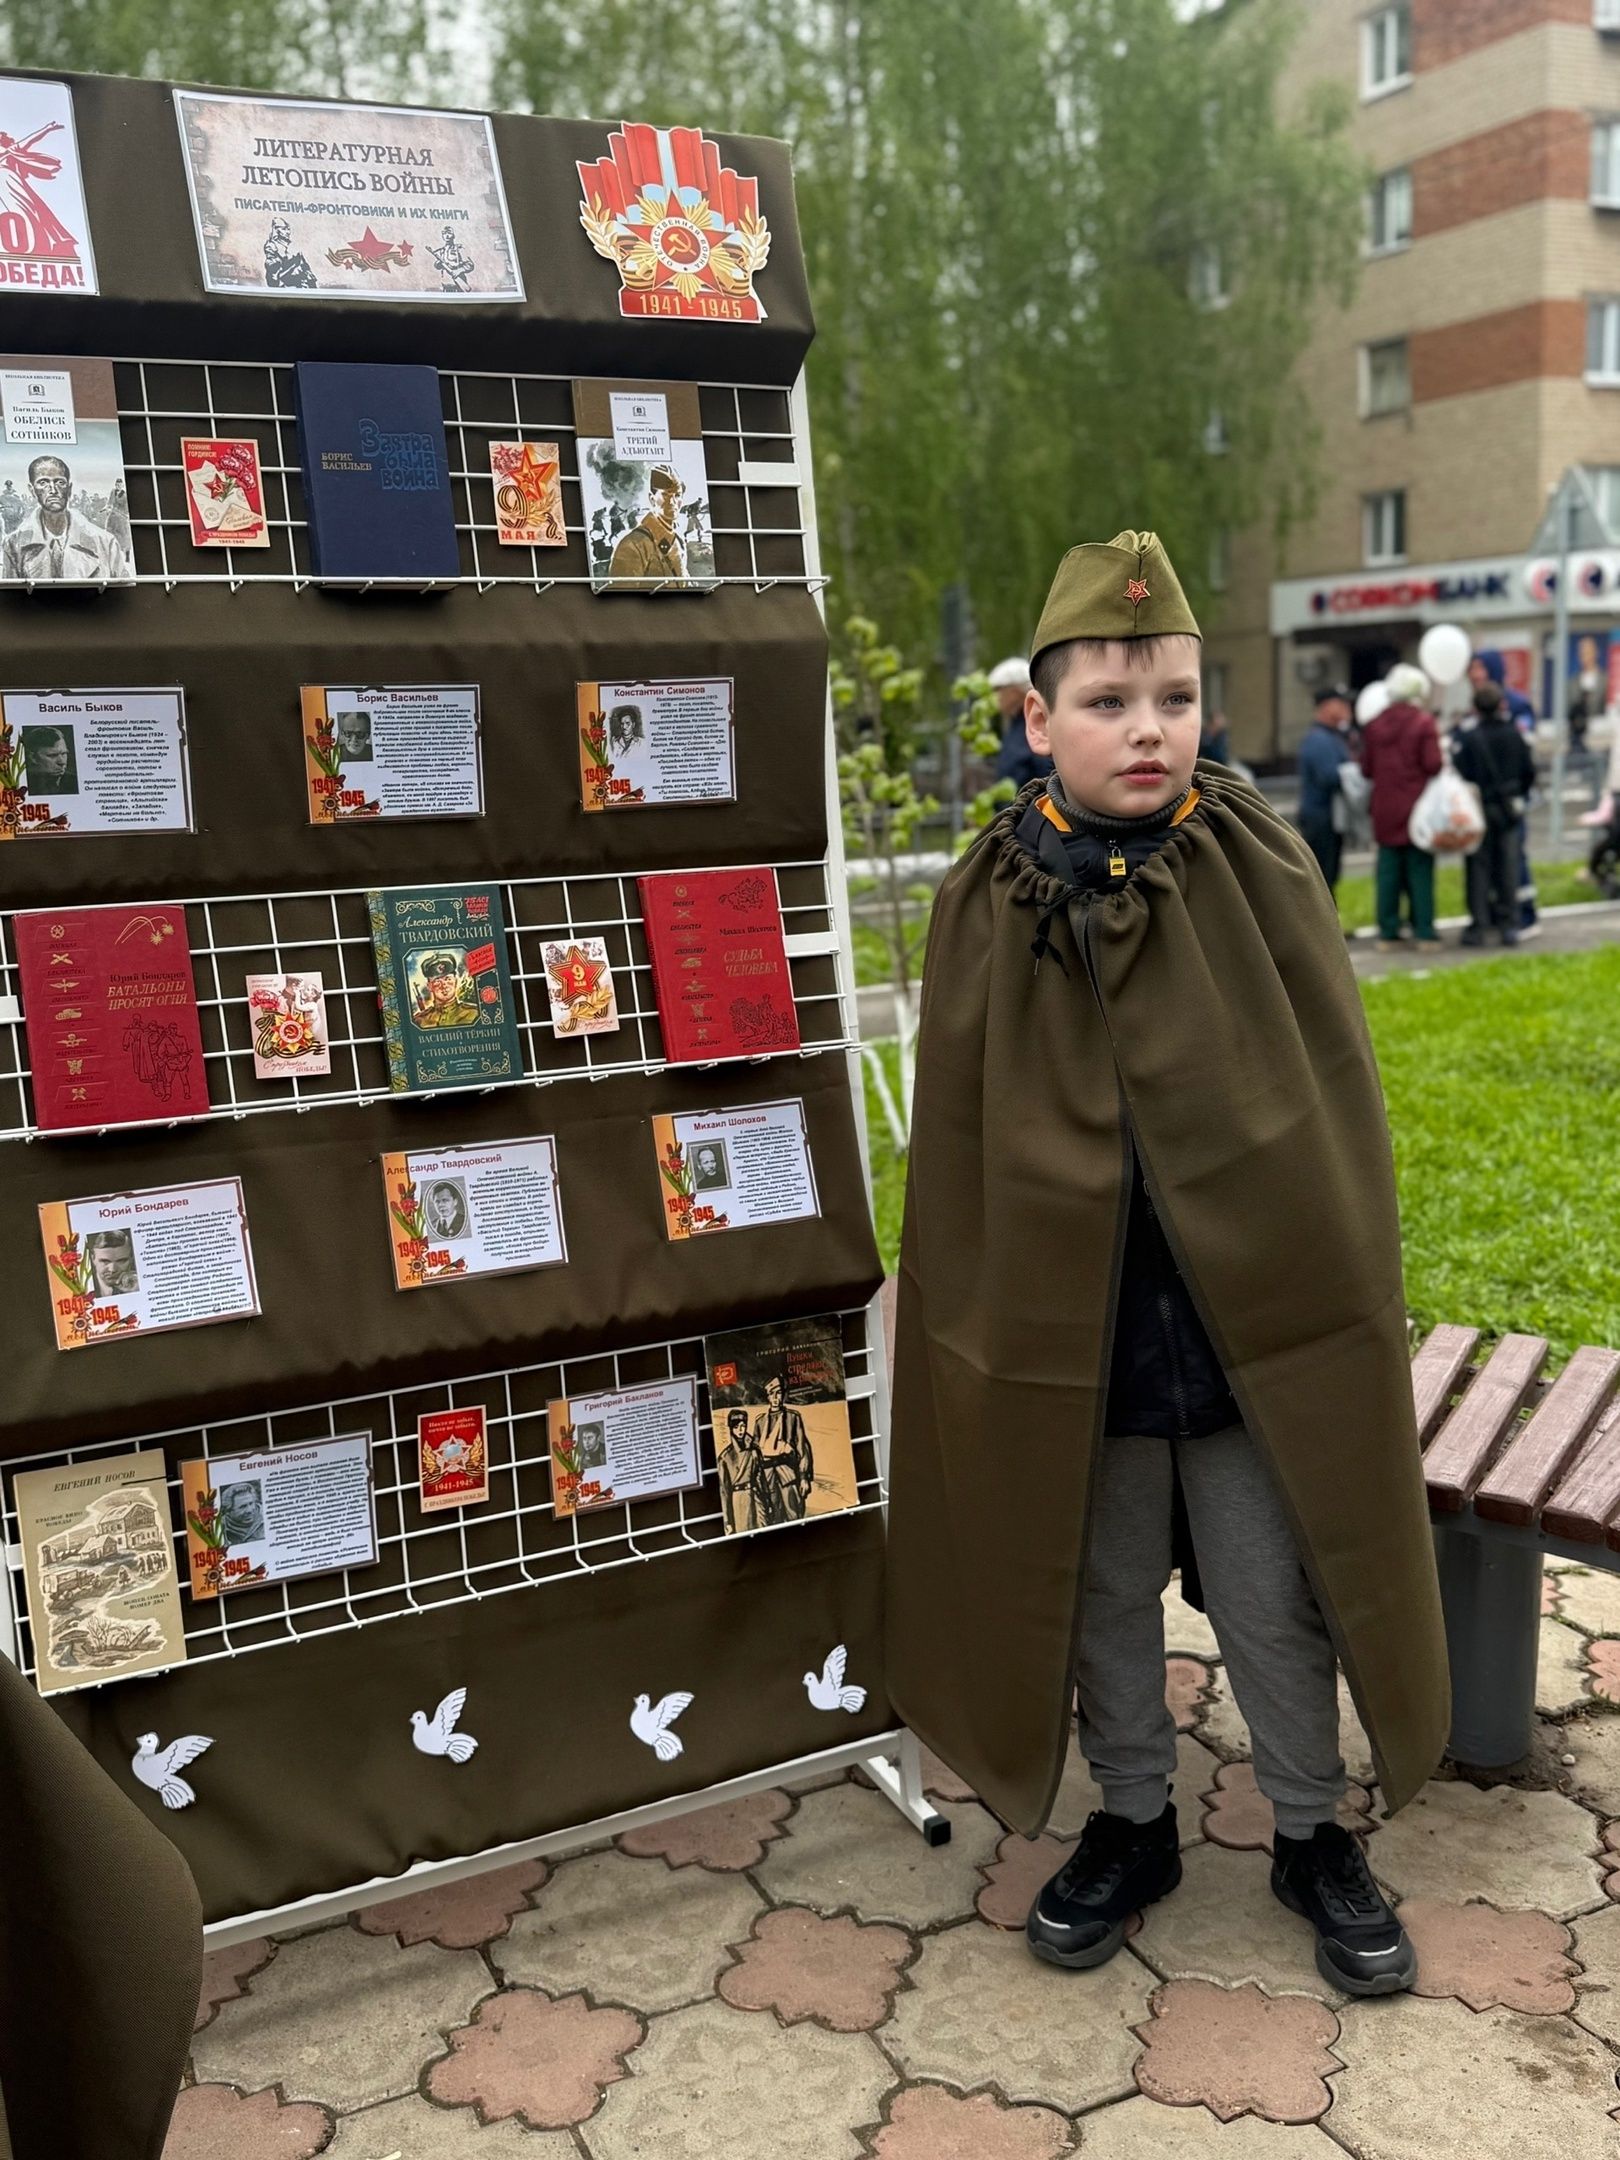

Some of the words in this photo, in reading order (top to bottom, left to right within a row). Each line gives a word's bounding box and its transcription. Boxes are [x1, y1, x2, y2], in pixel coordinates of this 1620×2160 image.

[253, 137, 434, 167] ЛИТЕРАТУРНАЯ
[242, 165, 366, 191] ЛЕТОПИСЬ
[369, 171, 455, 196] ВОЙНЫ
[234, 197, 394, 218] ПИСАТЕЛИ-ФРОНТОВИКИ
[399, 207, 407, 218] И
[410, 208, 426, 219] ИХ
[429, 209, 469, 221] КНИГИ
[639, 296, 680, 315] 1941
[699, 298, 743, 319] 1945
[14, 415, 66, 425] ОБЕЛИСК
[11, 430, 72, 440] СОТНИКОВ
[626, 435, 658, 445] ТРЕТИЙ
[321, 452, 353, 461] БОРИС
[622, 447, 665, 456] АДЪЮТАНТ
[321, 461, 373, 471] ВАСИЛЬЕВ
[501, 530, 536, 540] МАЯ
[357, 693, 388, 705] Борис
[390, 693, 439, 702] Васильев
[614, 687, 664, 697] Константин
[666, 686, 706, 695] Симонов
[38, 703, 82, 713] Василь
[85, 702, 123, 712] Быков
[584, 767, 606, 783] 1941
[311, 778, 334, 794] 1941
[608, 779, 631, 795] 1945
[339, 790, 365, 807] 1945
[20, 803, 51, 823] 1945
[398, 914, 453, 929] Александр
[399, 923, 494, 944] ТВАРДОВСКИЙ
[724, 947, 763, 962] СУДЬБА
[571, 964, 585, 981] 9
[725, 961, 779, 977] ЧЕЛОВЕКА
[110, 973, 139, 984] Юрий
[142, 971, 186, 982] Бондарев
[106, 981, 187, 998] БАТАЛЬОНЫ
[108, 996, 155, 1011] ПРОСЯТ
[156, 993, 188, 1007] ОГНЯ
[418, 1030, 463, 1044] ВАСИЛИЙ
[464, 1028, 501, 1040] ТЁРКИН
[422, 1042, 501, 1057] СТИХОТВОРЕНИЯ
[693, 1121, 726, 1131] Михаил
[728, 1115, 767, 1127] Шолохов
[386, 1162, 439, 1176] Александр
[440, 1153, 502, 1169] Твардовский
[98, 1205, 132, 1219] Юрий
[134, 1197, 189, 1214] Бондарев
[667, 1198, 688, 1214] 1941
[692, 1205, 715, 1222] 1945
[397, 1241, 420, 1258] 1941
[424, 1249, 451, 1268] 1945
[57, 1296, 83, 1316] 1941
[90, 1305, 120, 1326] 1945
[584, 1397, 624, 1412] Григорий
[625, 1390, 664, 1403] Бакланов
[239, 1457, 283, 1472] Евгений
[285, 1450, 318, 1463] Носов
[54, 1476, 103, 1492] ЕВГЕНИЙ
[105, 1470, 136, 1483] НОСОВ
[434, 1478, 474, 1492] 1941-1945
[556, 1475, 578, 1490] 1941
[579, 1480, 601, 1497] 1945
[193, 1550, 219, 1568] 1941
[223, 1556, 251, 1577] 1945
